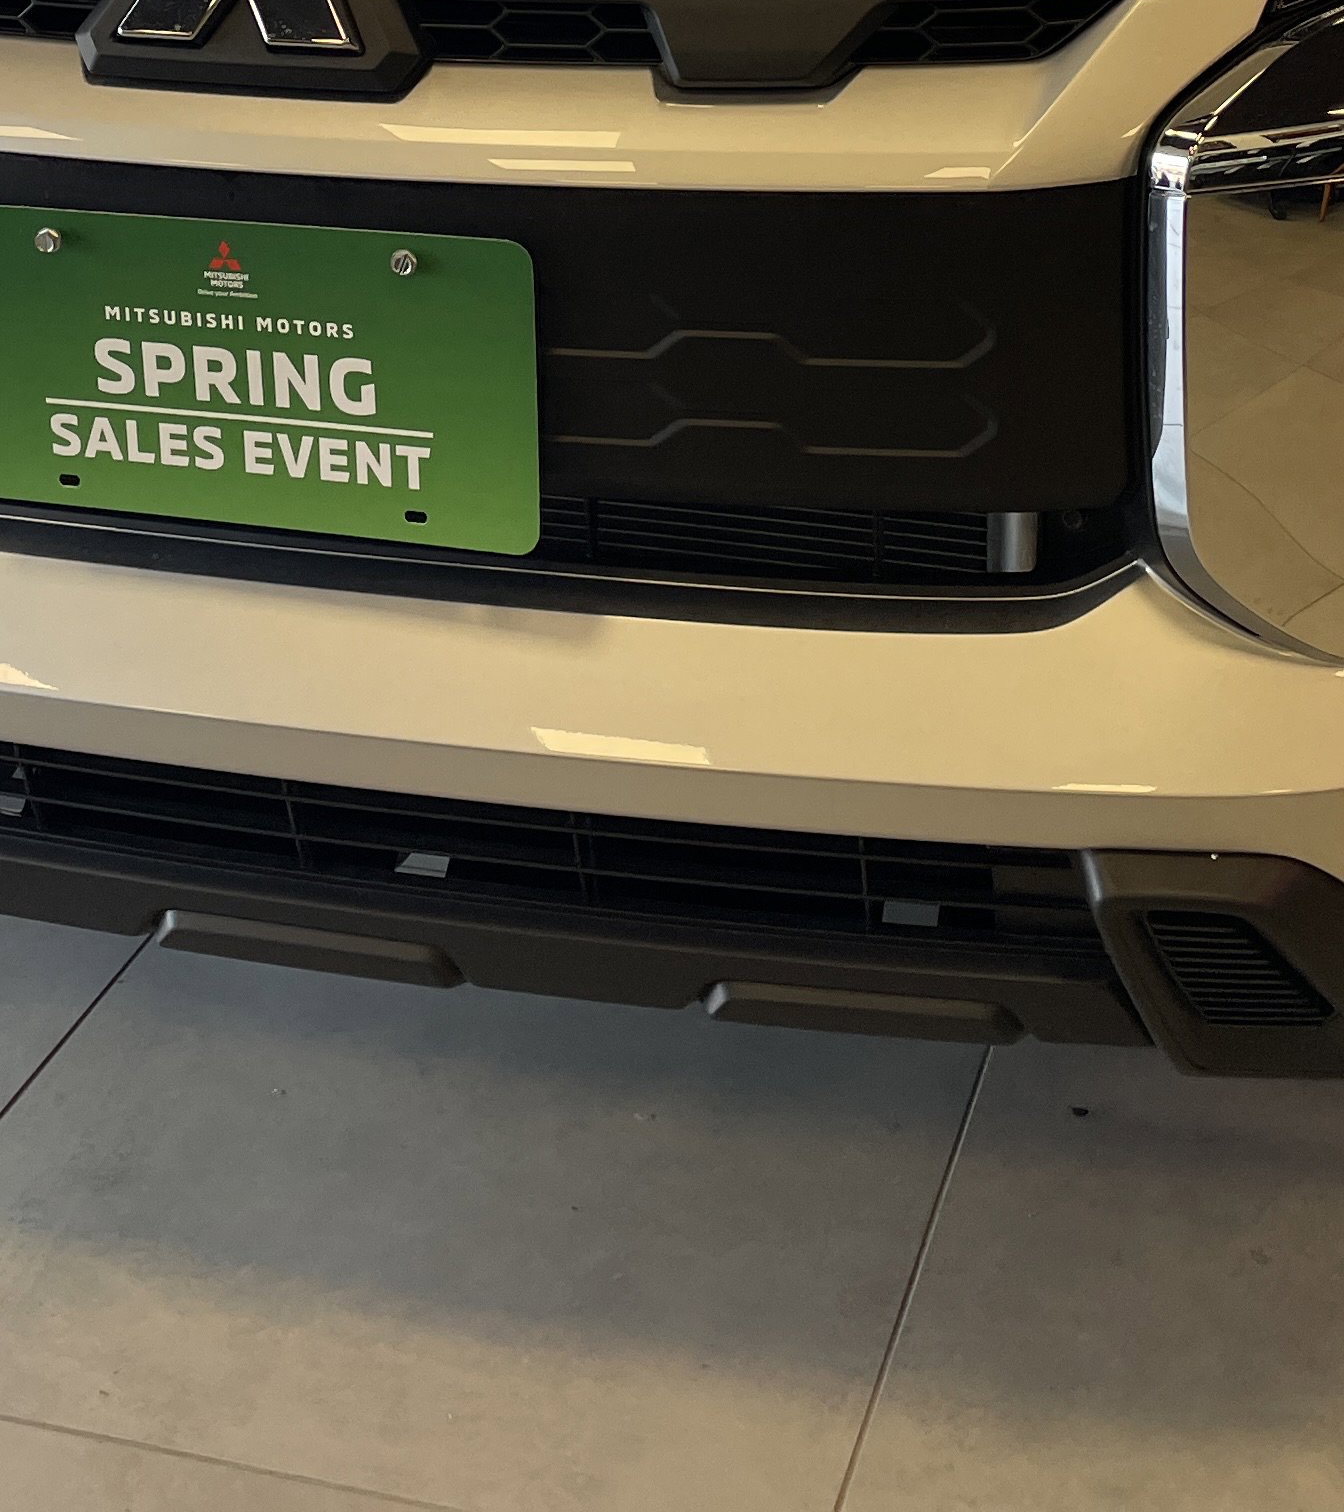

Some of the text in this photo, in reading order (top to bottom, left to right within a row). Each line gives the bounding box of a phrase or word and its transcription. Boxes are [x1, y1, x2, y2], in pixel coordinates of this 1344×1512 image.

[203, 270, 250, 281] MITSUBISHI
[210, 279, 244, 289] MOTORS
[104, 304, 356, 339] MITSUBISHI MOTORS
[93, 336, 378, 417] SPRING
[48, 412, 432, 491] SALES EVENT
